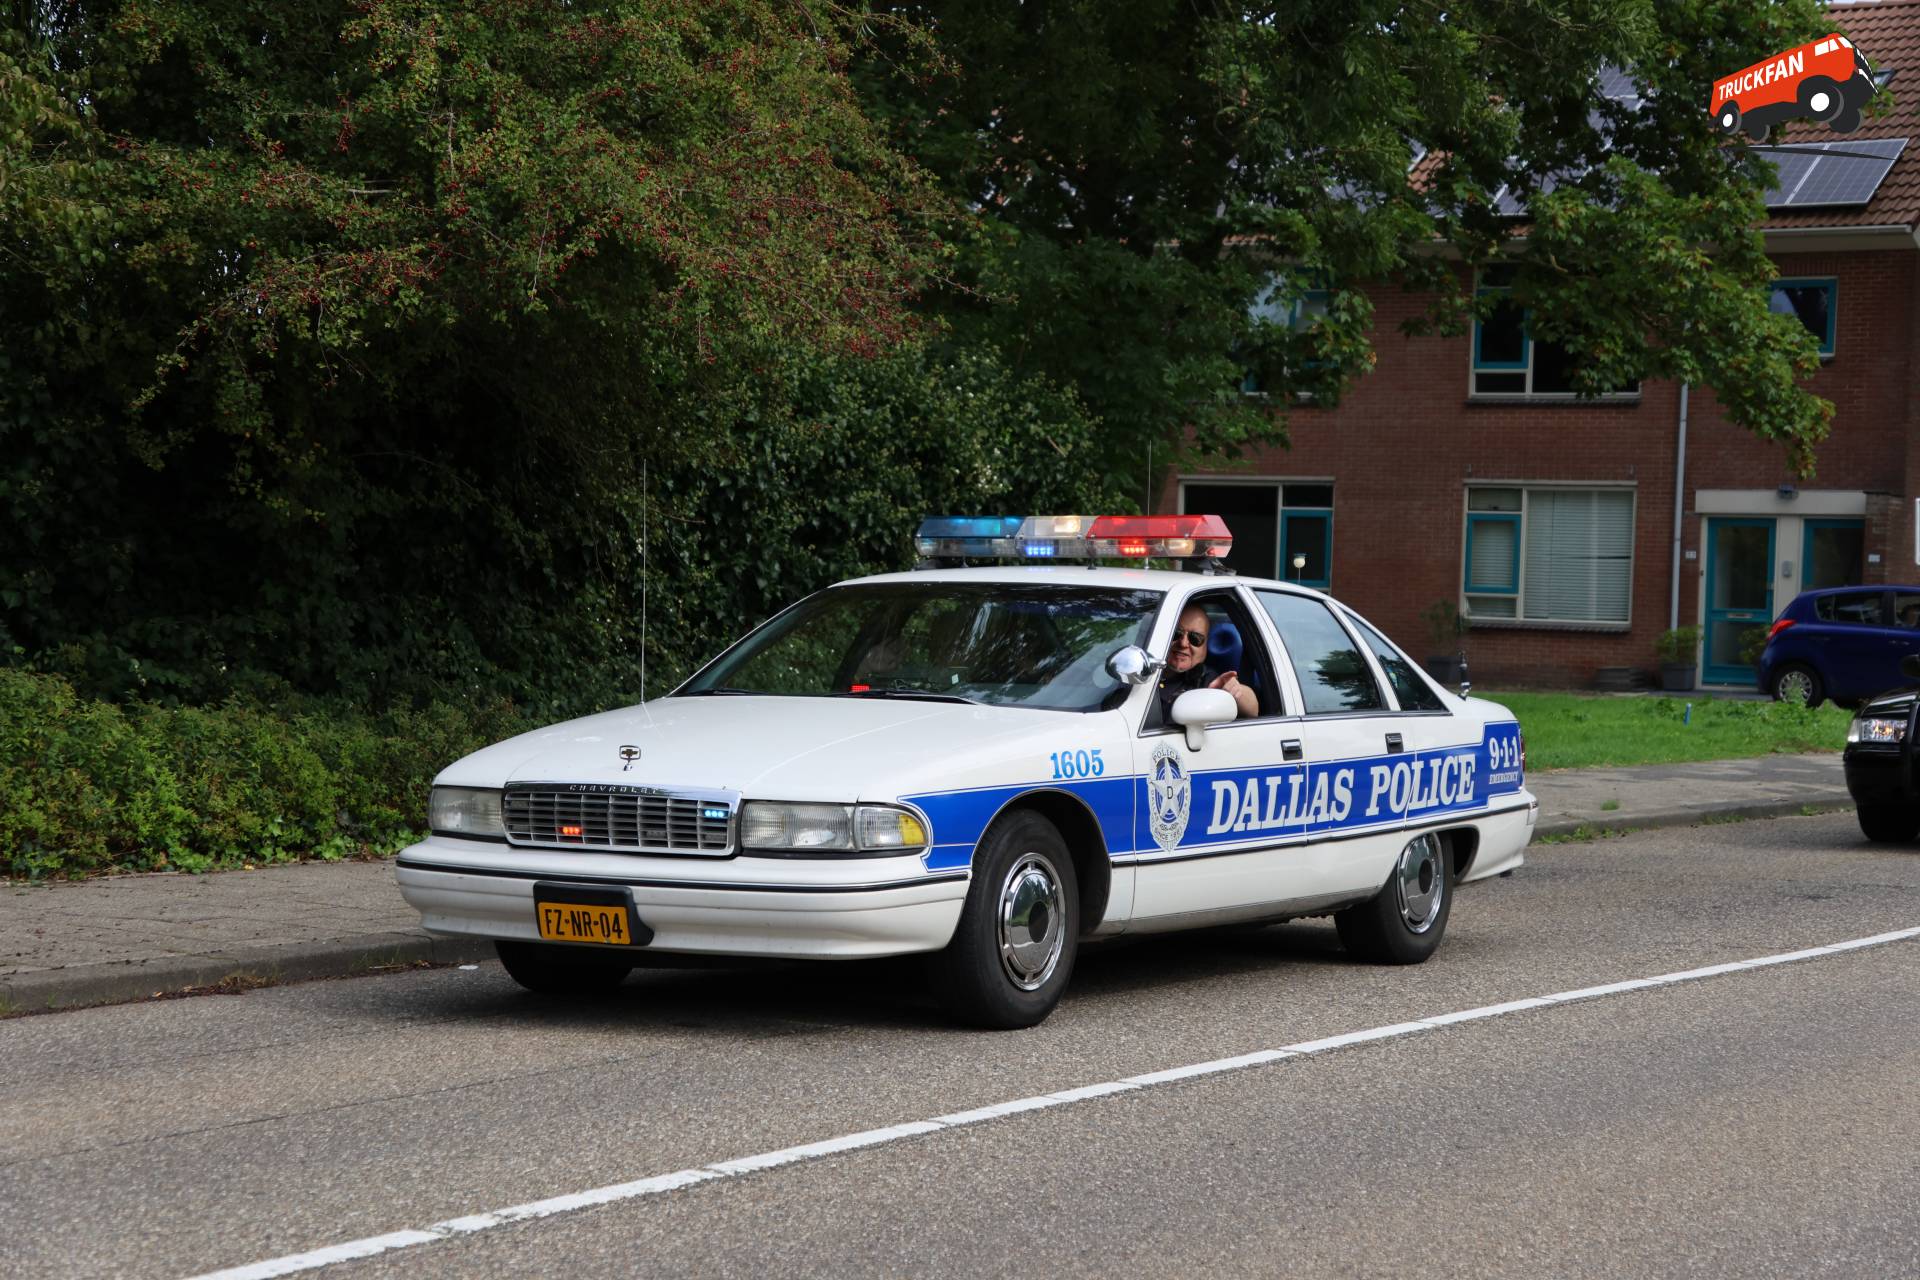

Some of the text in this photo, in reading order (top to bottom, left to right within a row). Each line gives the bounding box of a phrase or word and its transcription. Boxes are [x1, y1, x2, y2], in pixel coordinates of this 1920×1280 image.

[1050, 748, 1104, 779] 1605
[1167, 786, 1174, 799] D
[1207, 769, 1355, 835] DALLAS
[1365, 753, 1476, 817] POLICE
[544, 908, 624, 940] FZ-NR-04
